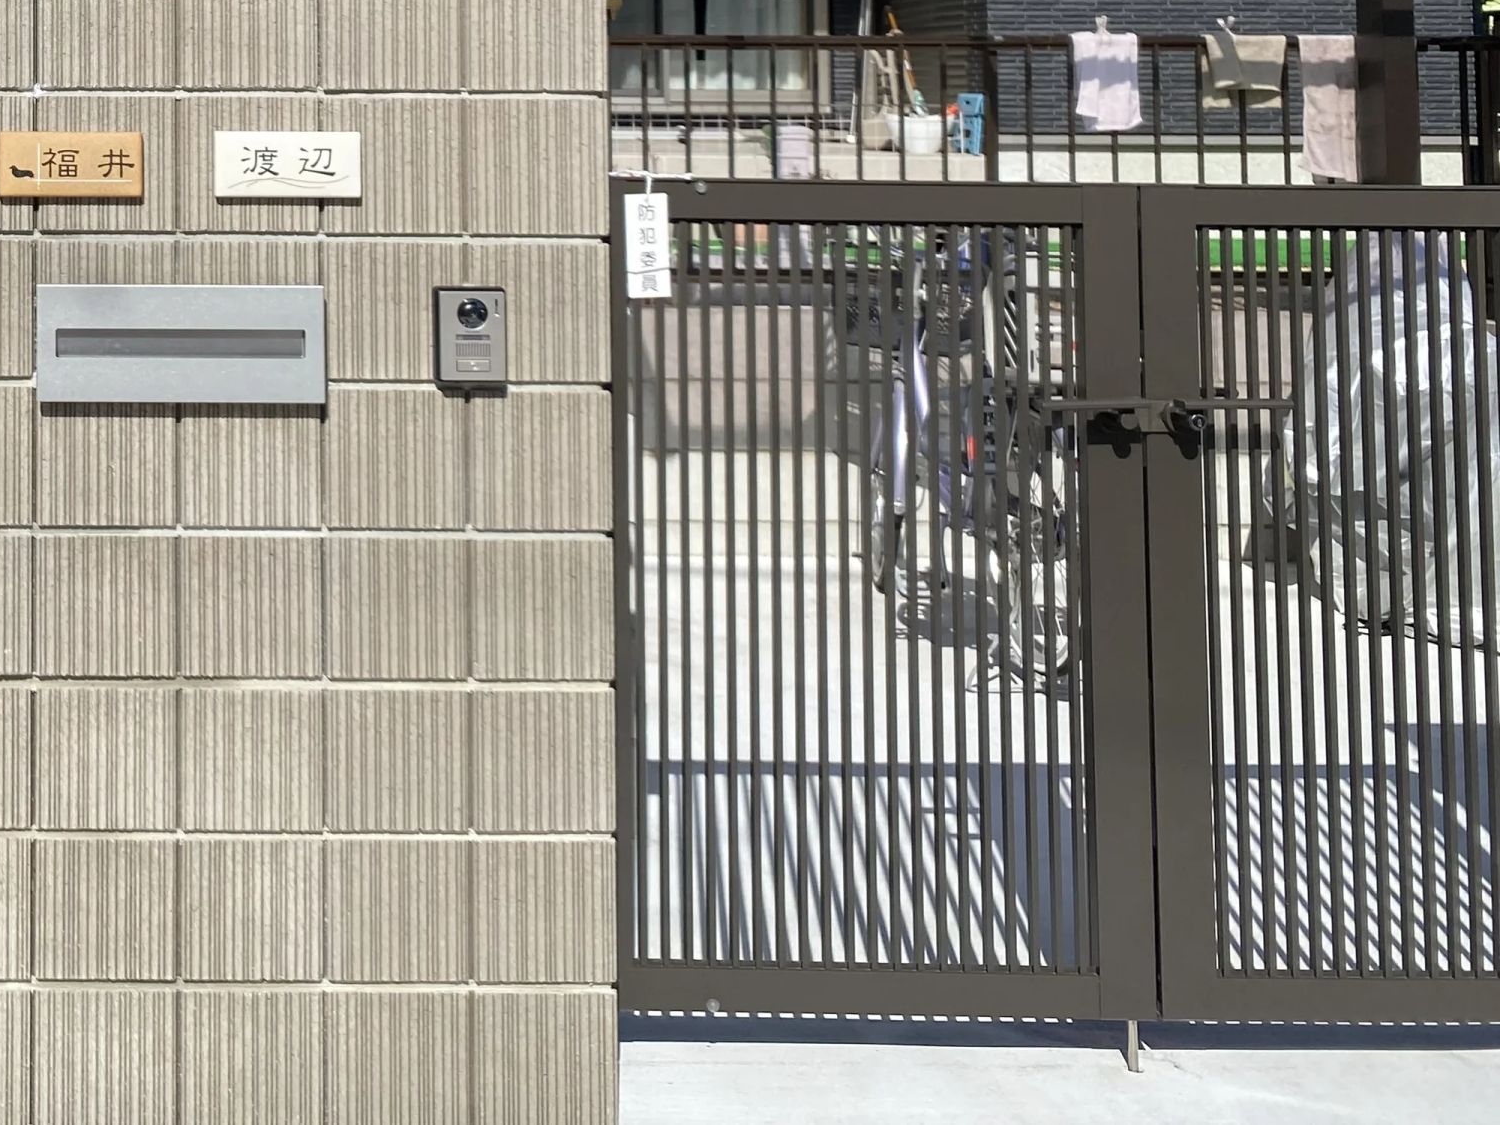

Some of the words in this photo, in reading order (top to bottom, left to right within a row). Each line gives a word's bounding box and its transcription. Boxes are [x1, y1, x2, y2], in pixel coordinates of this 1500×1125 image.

[41, 147, 135, 179] 福井
[240, 146, 337, 176] 渡辺
[638, 203, 659, 293] 防犯委員
